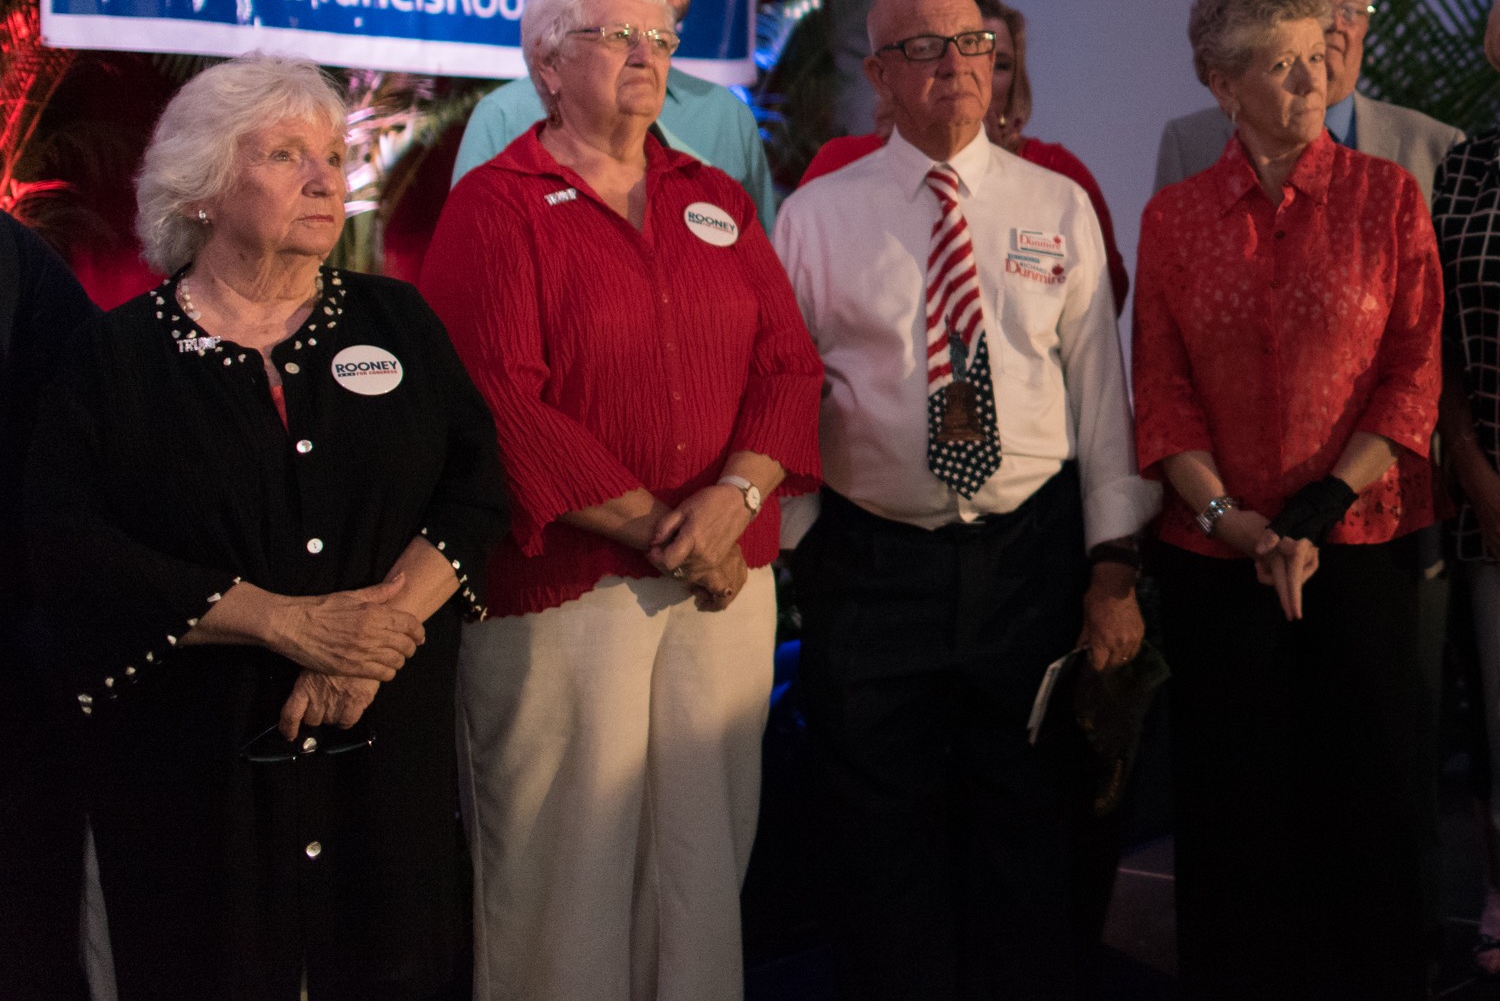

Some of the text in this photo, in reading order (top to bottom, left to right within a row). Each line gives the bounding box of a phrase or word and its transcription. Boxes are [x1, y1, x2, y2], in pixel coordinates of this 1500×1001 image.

[688, 211, 735, 232] ROONEY
[1005, 258, 1066, 284] Dunmire
[335, 361, 397, 373] ROONEY
